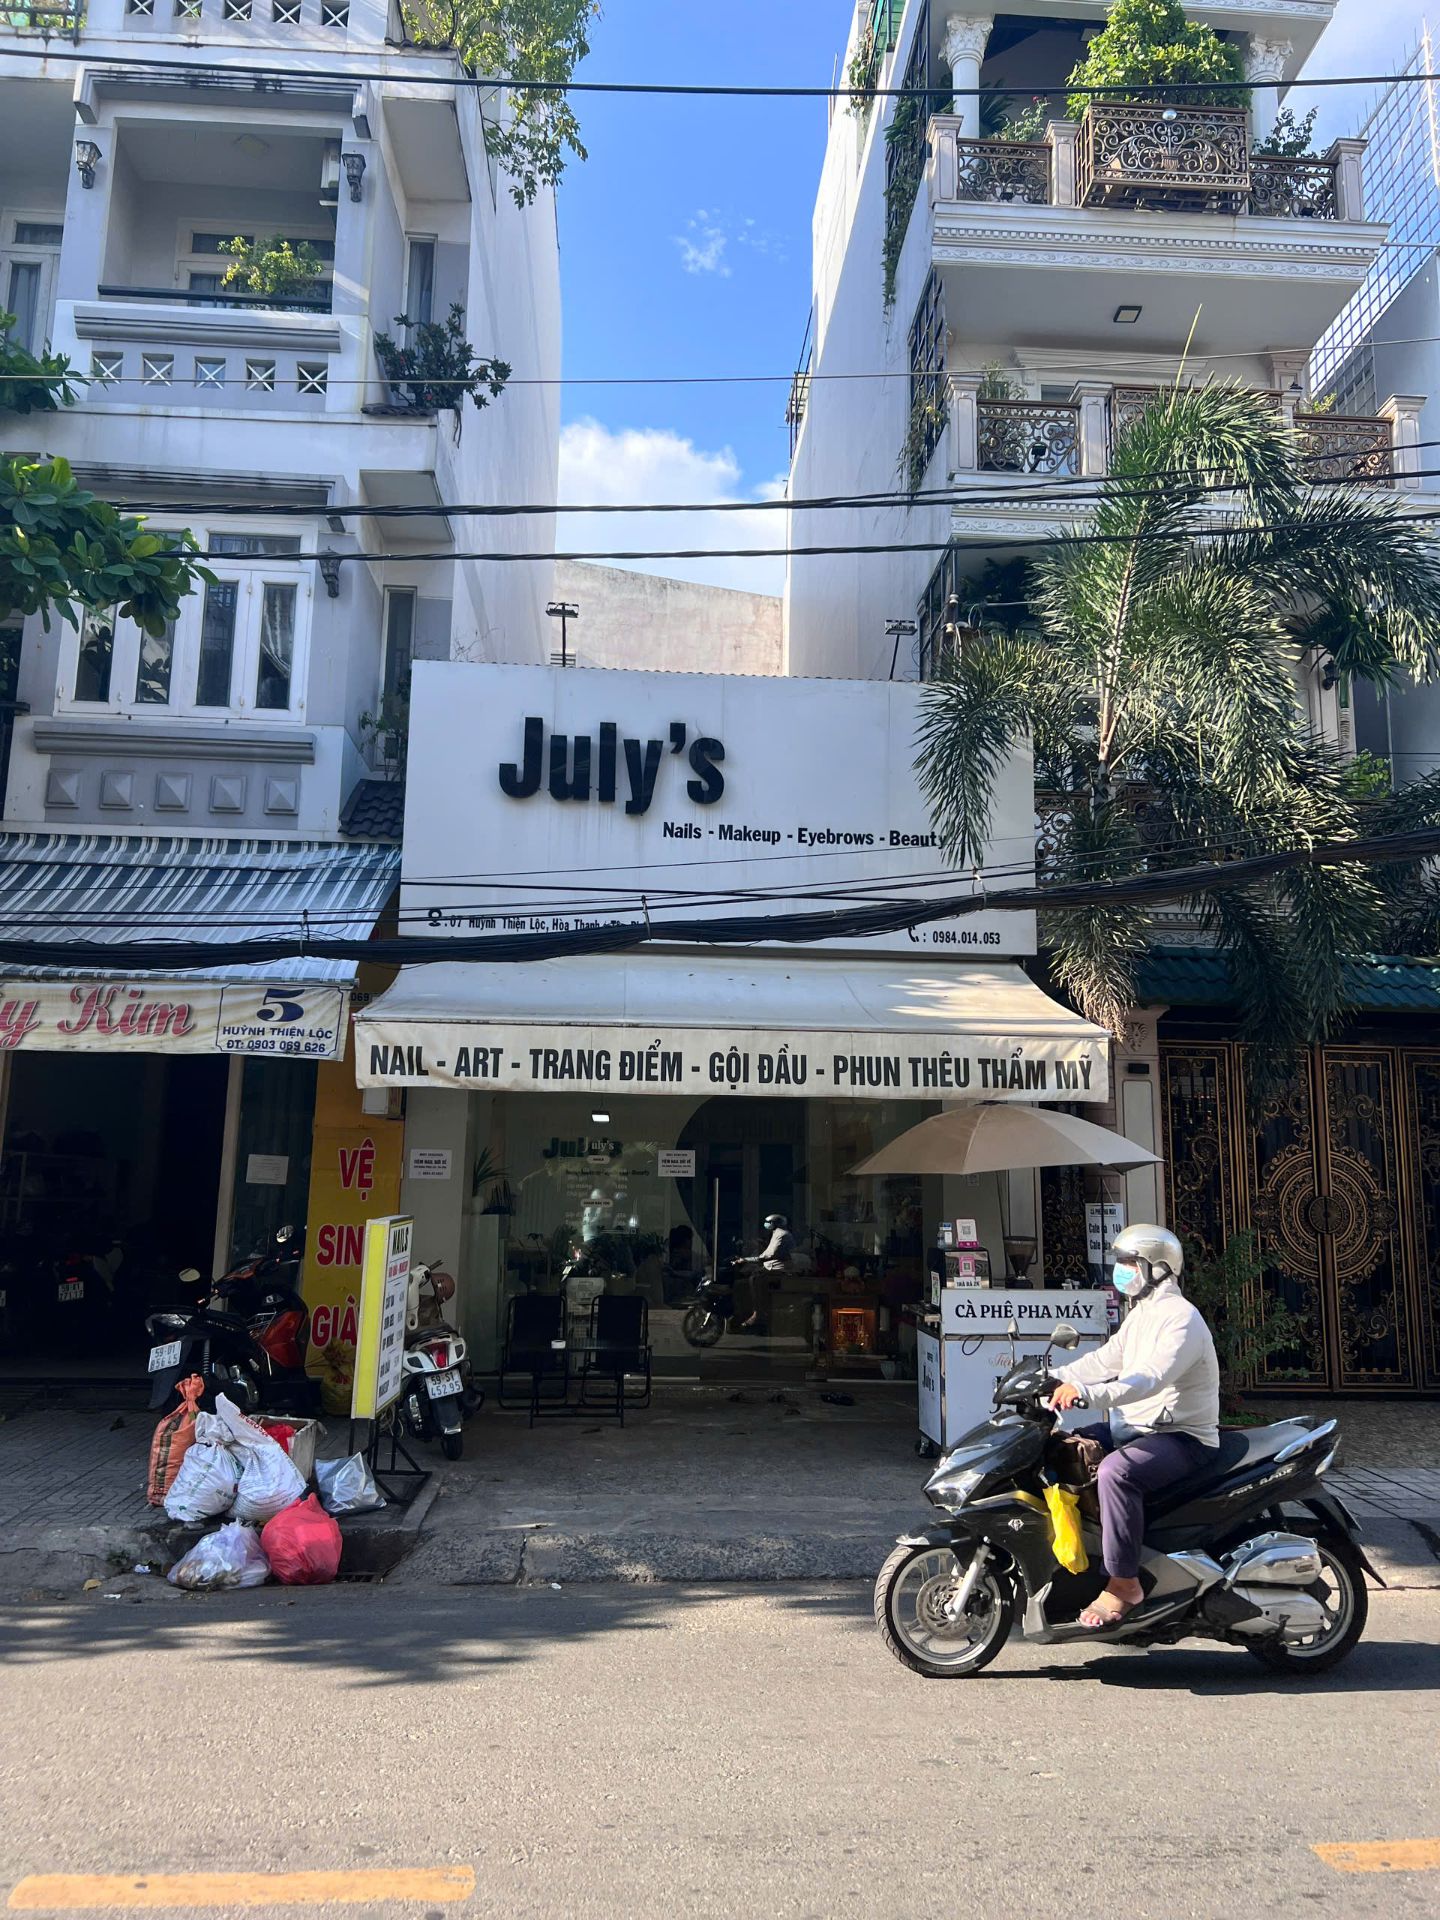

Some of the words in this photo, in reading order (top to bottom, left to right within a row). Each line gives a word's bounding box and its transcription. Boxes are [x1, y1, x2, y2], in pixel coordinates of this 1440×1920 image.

[499, 717, 725, 815] July's
[663, 822, 701, 839] Nails
[718, 825, 781, 844] Makeup
[798, 828, 874, 846] Eyebrows
[502, 917, 526, 932] Thiện
[529, 918, 549, 933] Lộc,
[552, 918, 569, 931] Hòa
[932, 930, 1001, 945] 0984.014.053
[57, 984, 196, 1036] Kim
[256, 988, 306, 1022] 5
[222, 1024, 265, 1037] HUỲNH
[270, 1026, 305, 1040] THIỆN
[309, 1028, 333, 1042] LỘC
[226, 1040, 244, 1050] ĐT:
[247, 1040, 275, 1051] 0903
[279, 1041, 300, 1051] 069
[304, 1042, 326, 1053] 626
[369, 1044, 429, 1077] NAIL
[454, 1046, 503, 1079] ART
[529, 1048, 611, 1081] TRANG
[618, 1039, 683, 1082] ĐIỂM
[709, 1046, 749, 1090] GỘI
[757, 1043, 807, 1086] ĐẦU
[833, 1054, 900, 1088] PHUN
[907, 1050, 970, 1088] THÊU
[977, 1046, 1047, 1090] THẨM
[1055, 1054, 1093, 1090] MỸ
[338, 1137, 376, 1201] VỆ
[316, 1224, 364, 1267] SIN
[310, 1295, 360, 1348] GIÀ
[955, 1299, 977, 1318] CÀ
[981, 1300, 1014, 1318] PHÊ
[1017, 1304, 1053, 1319] PHA
[1055, 1300, 1094, 1319] MÁY
